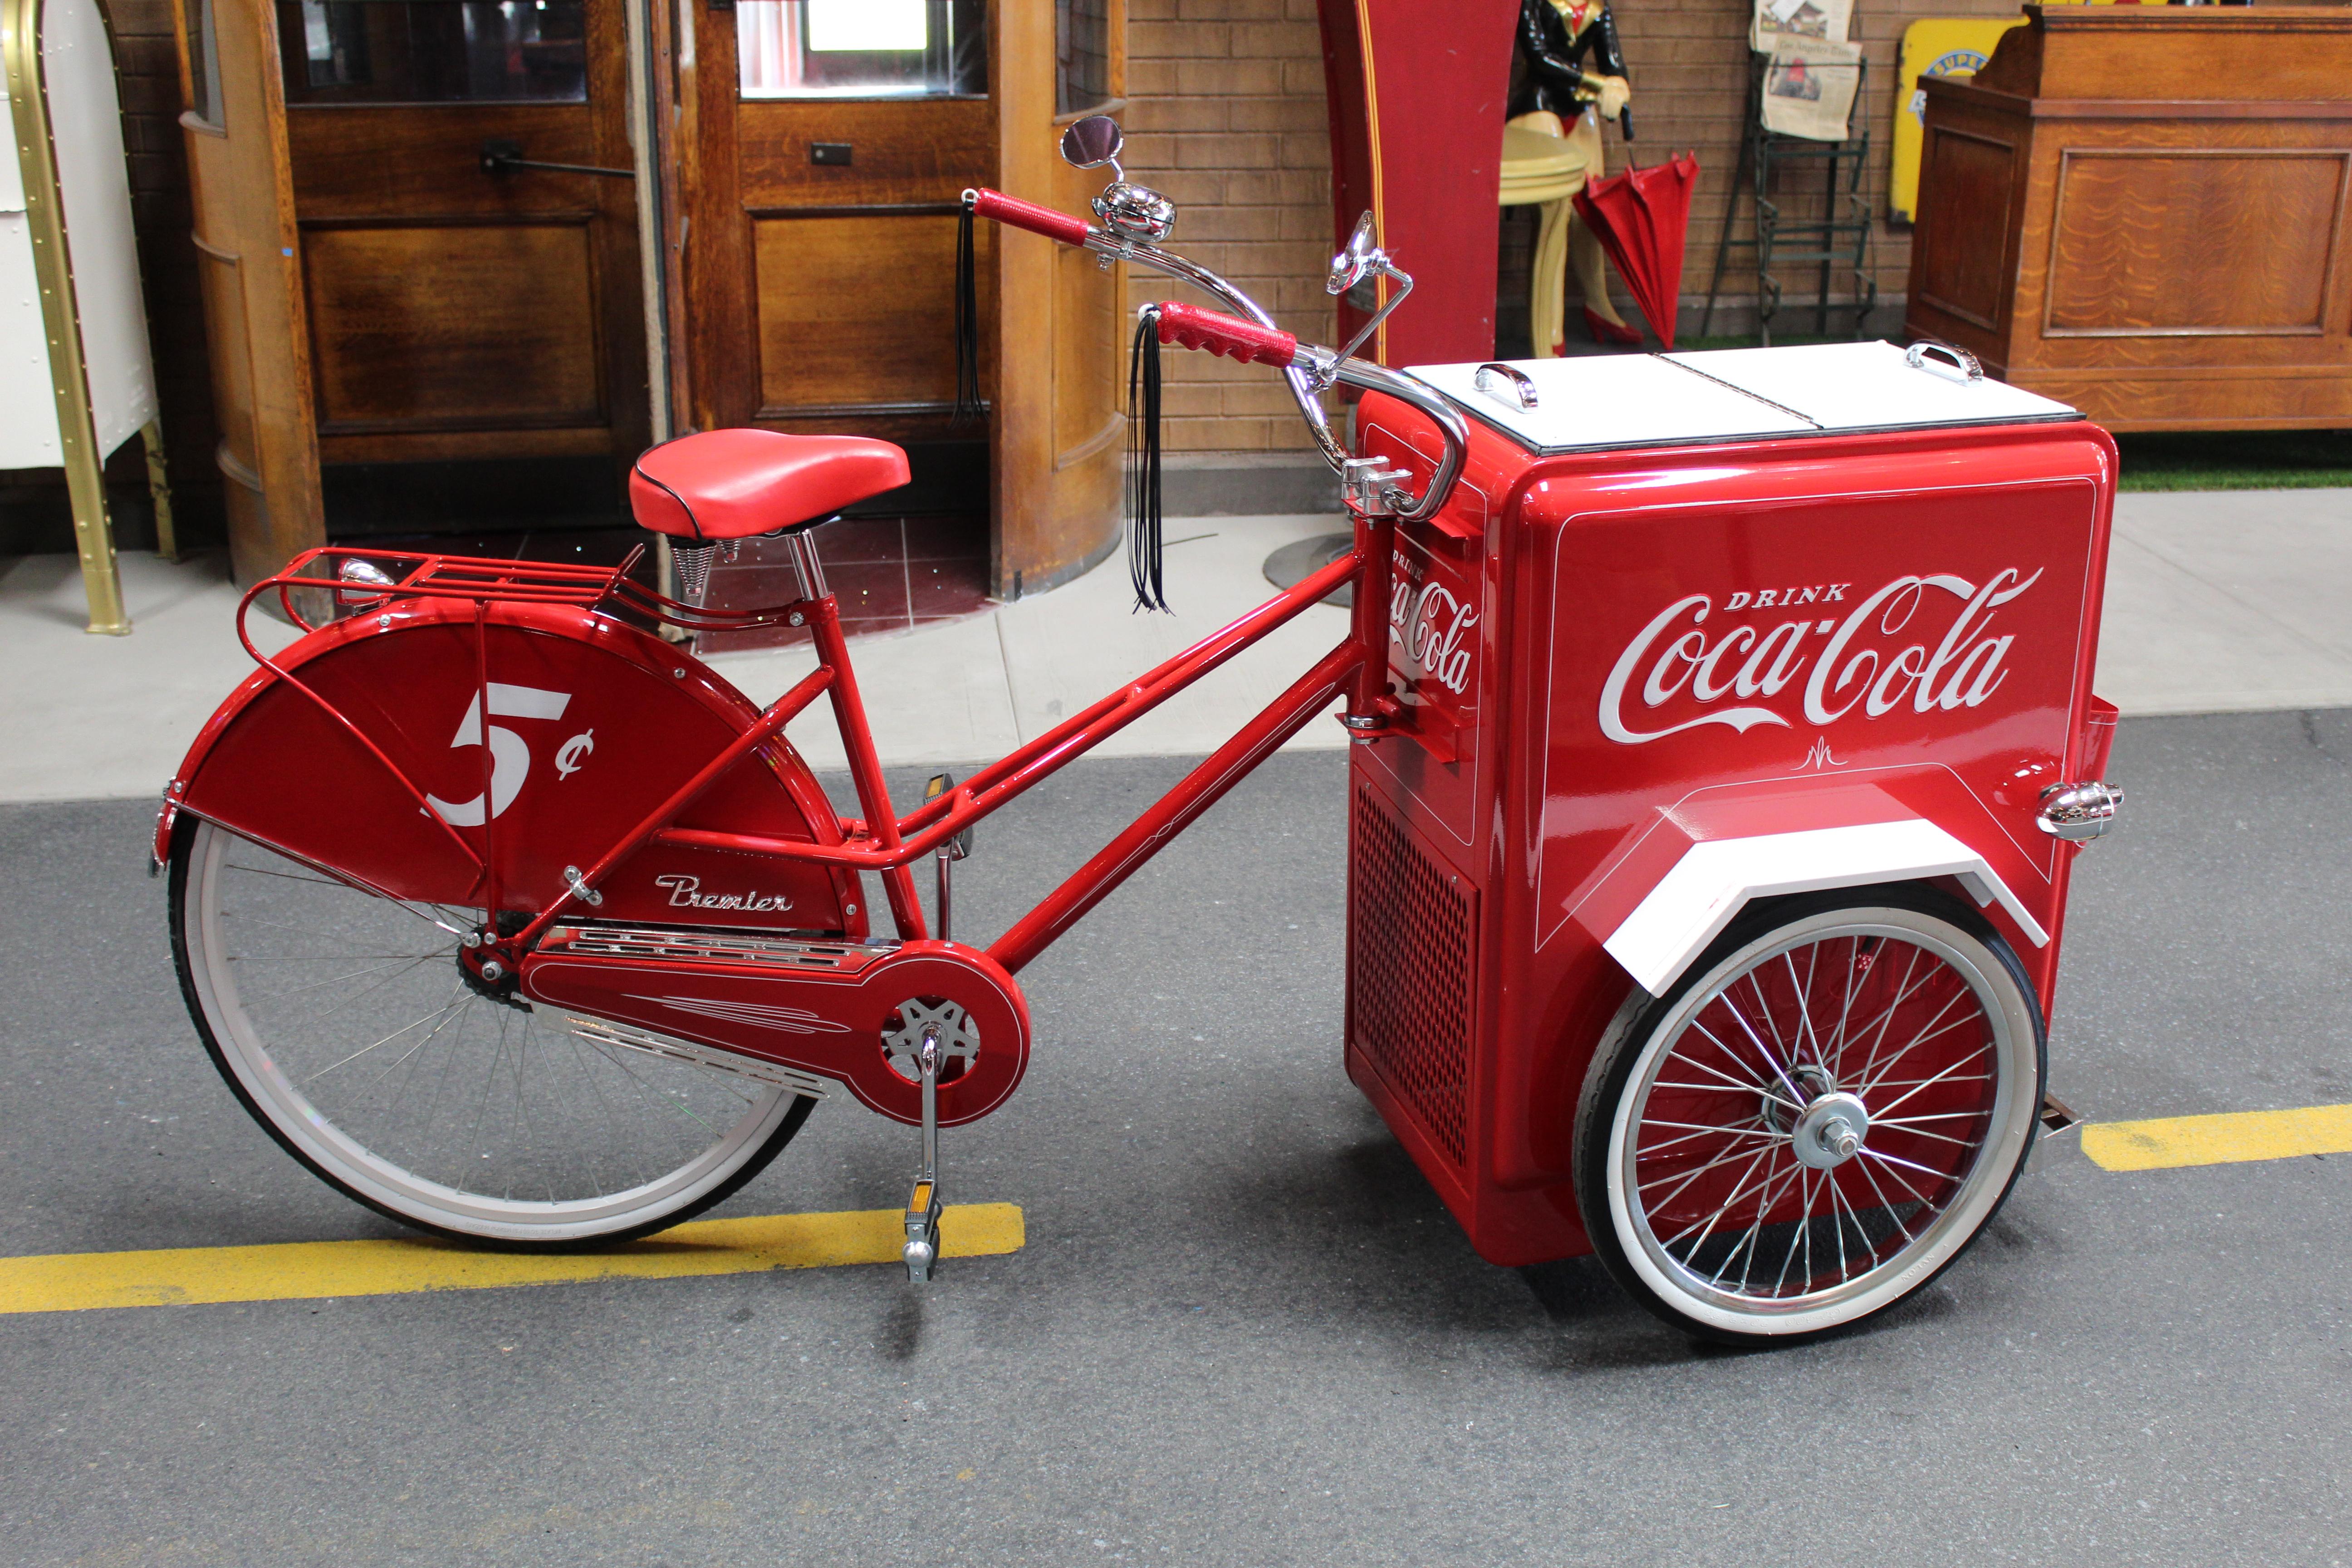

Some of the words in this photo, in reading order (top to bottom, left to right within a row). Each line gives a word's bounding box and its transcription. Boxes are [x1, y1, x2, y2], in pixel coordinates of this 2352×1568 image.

[1392, 549, 1424, 582] DRINK
[1723, 583, 1851, 611] DRINK
[1598, 567, 2044, 745] Coca-Cola
[655, 874, 794, 911] Premier
